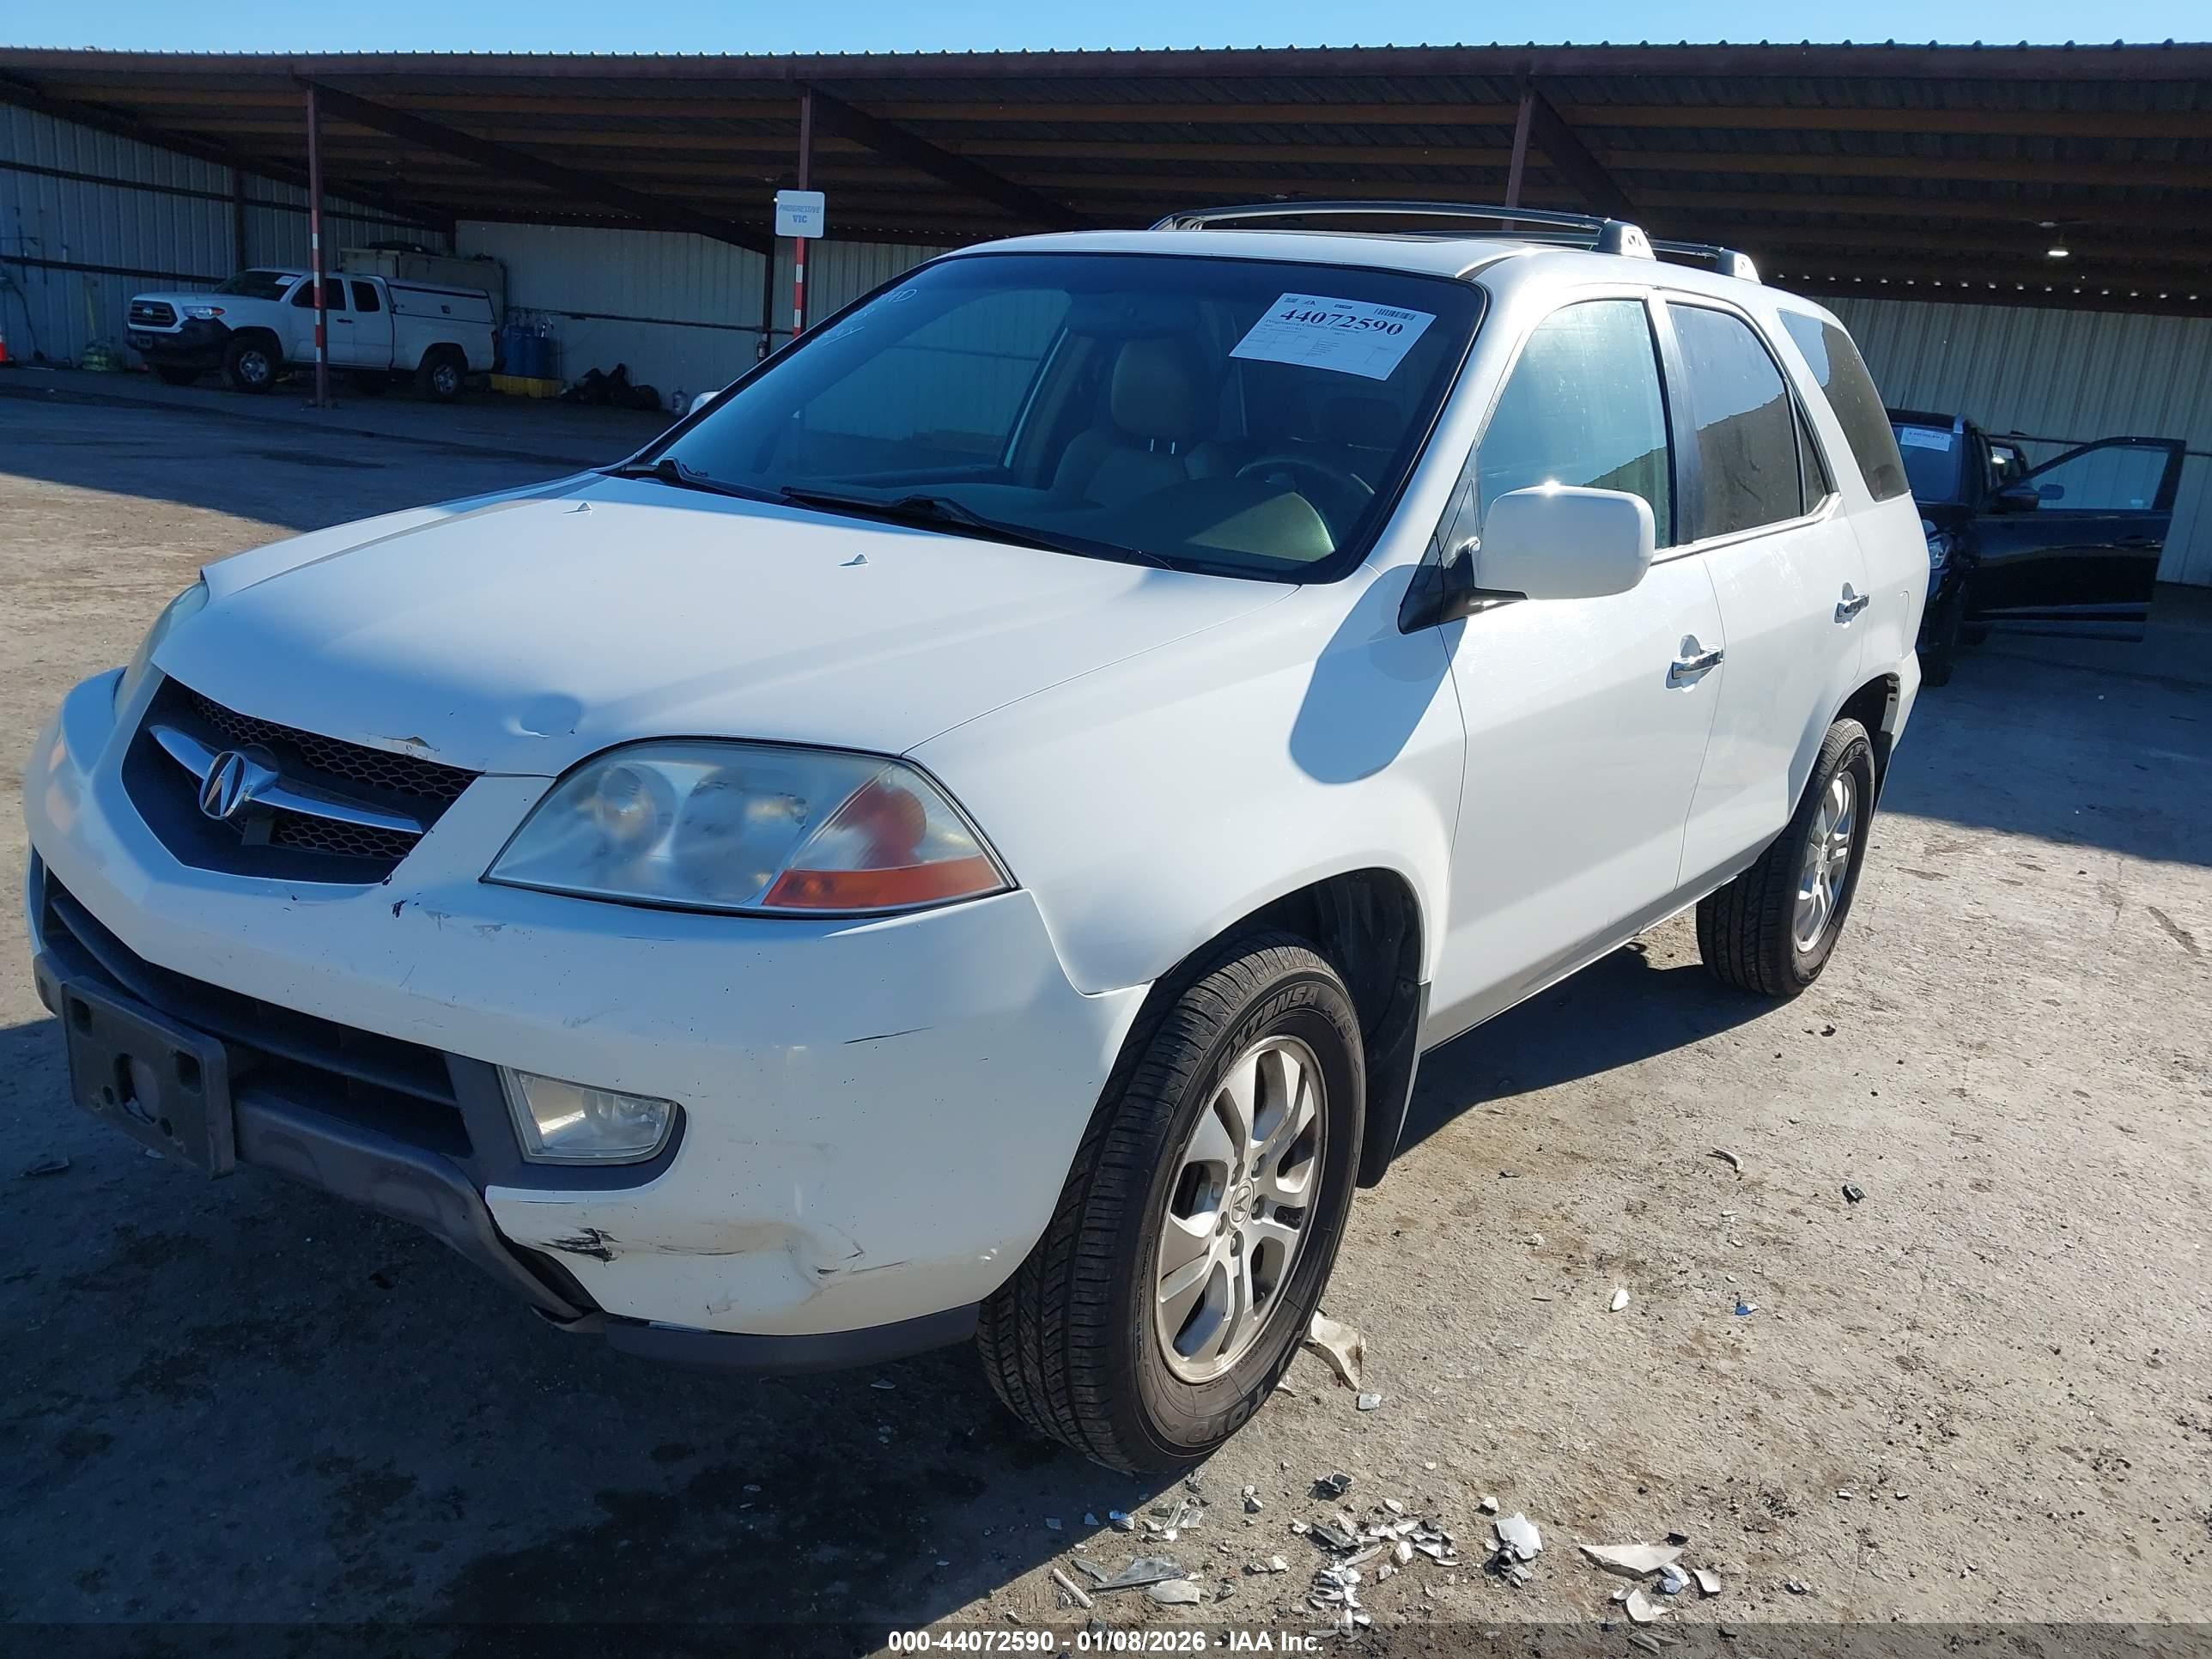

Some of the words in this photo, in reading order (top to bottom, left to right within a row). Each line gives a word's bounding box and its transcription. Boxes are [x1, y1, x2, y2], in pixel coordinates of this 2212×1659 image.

[792, 215, 808, 223] VIC
[1280, 309, 1404, 336] 44072590
[1215, 985, 1318, 1075] EXTENSA
[1186, 1383, 1268, 1443] TOYO
